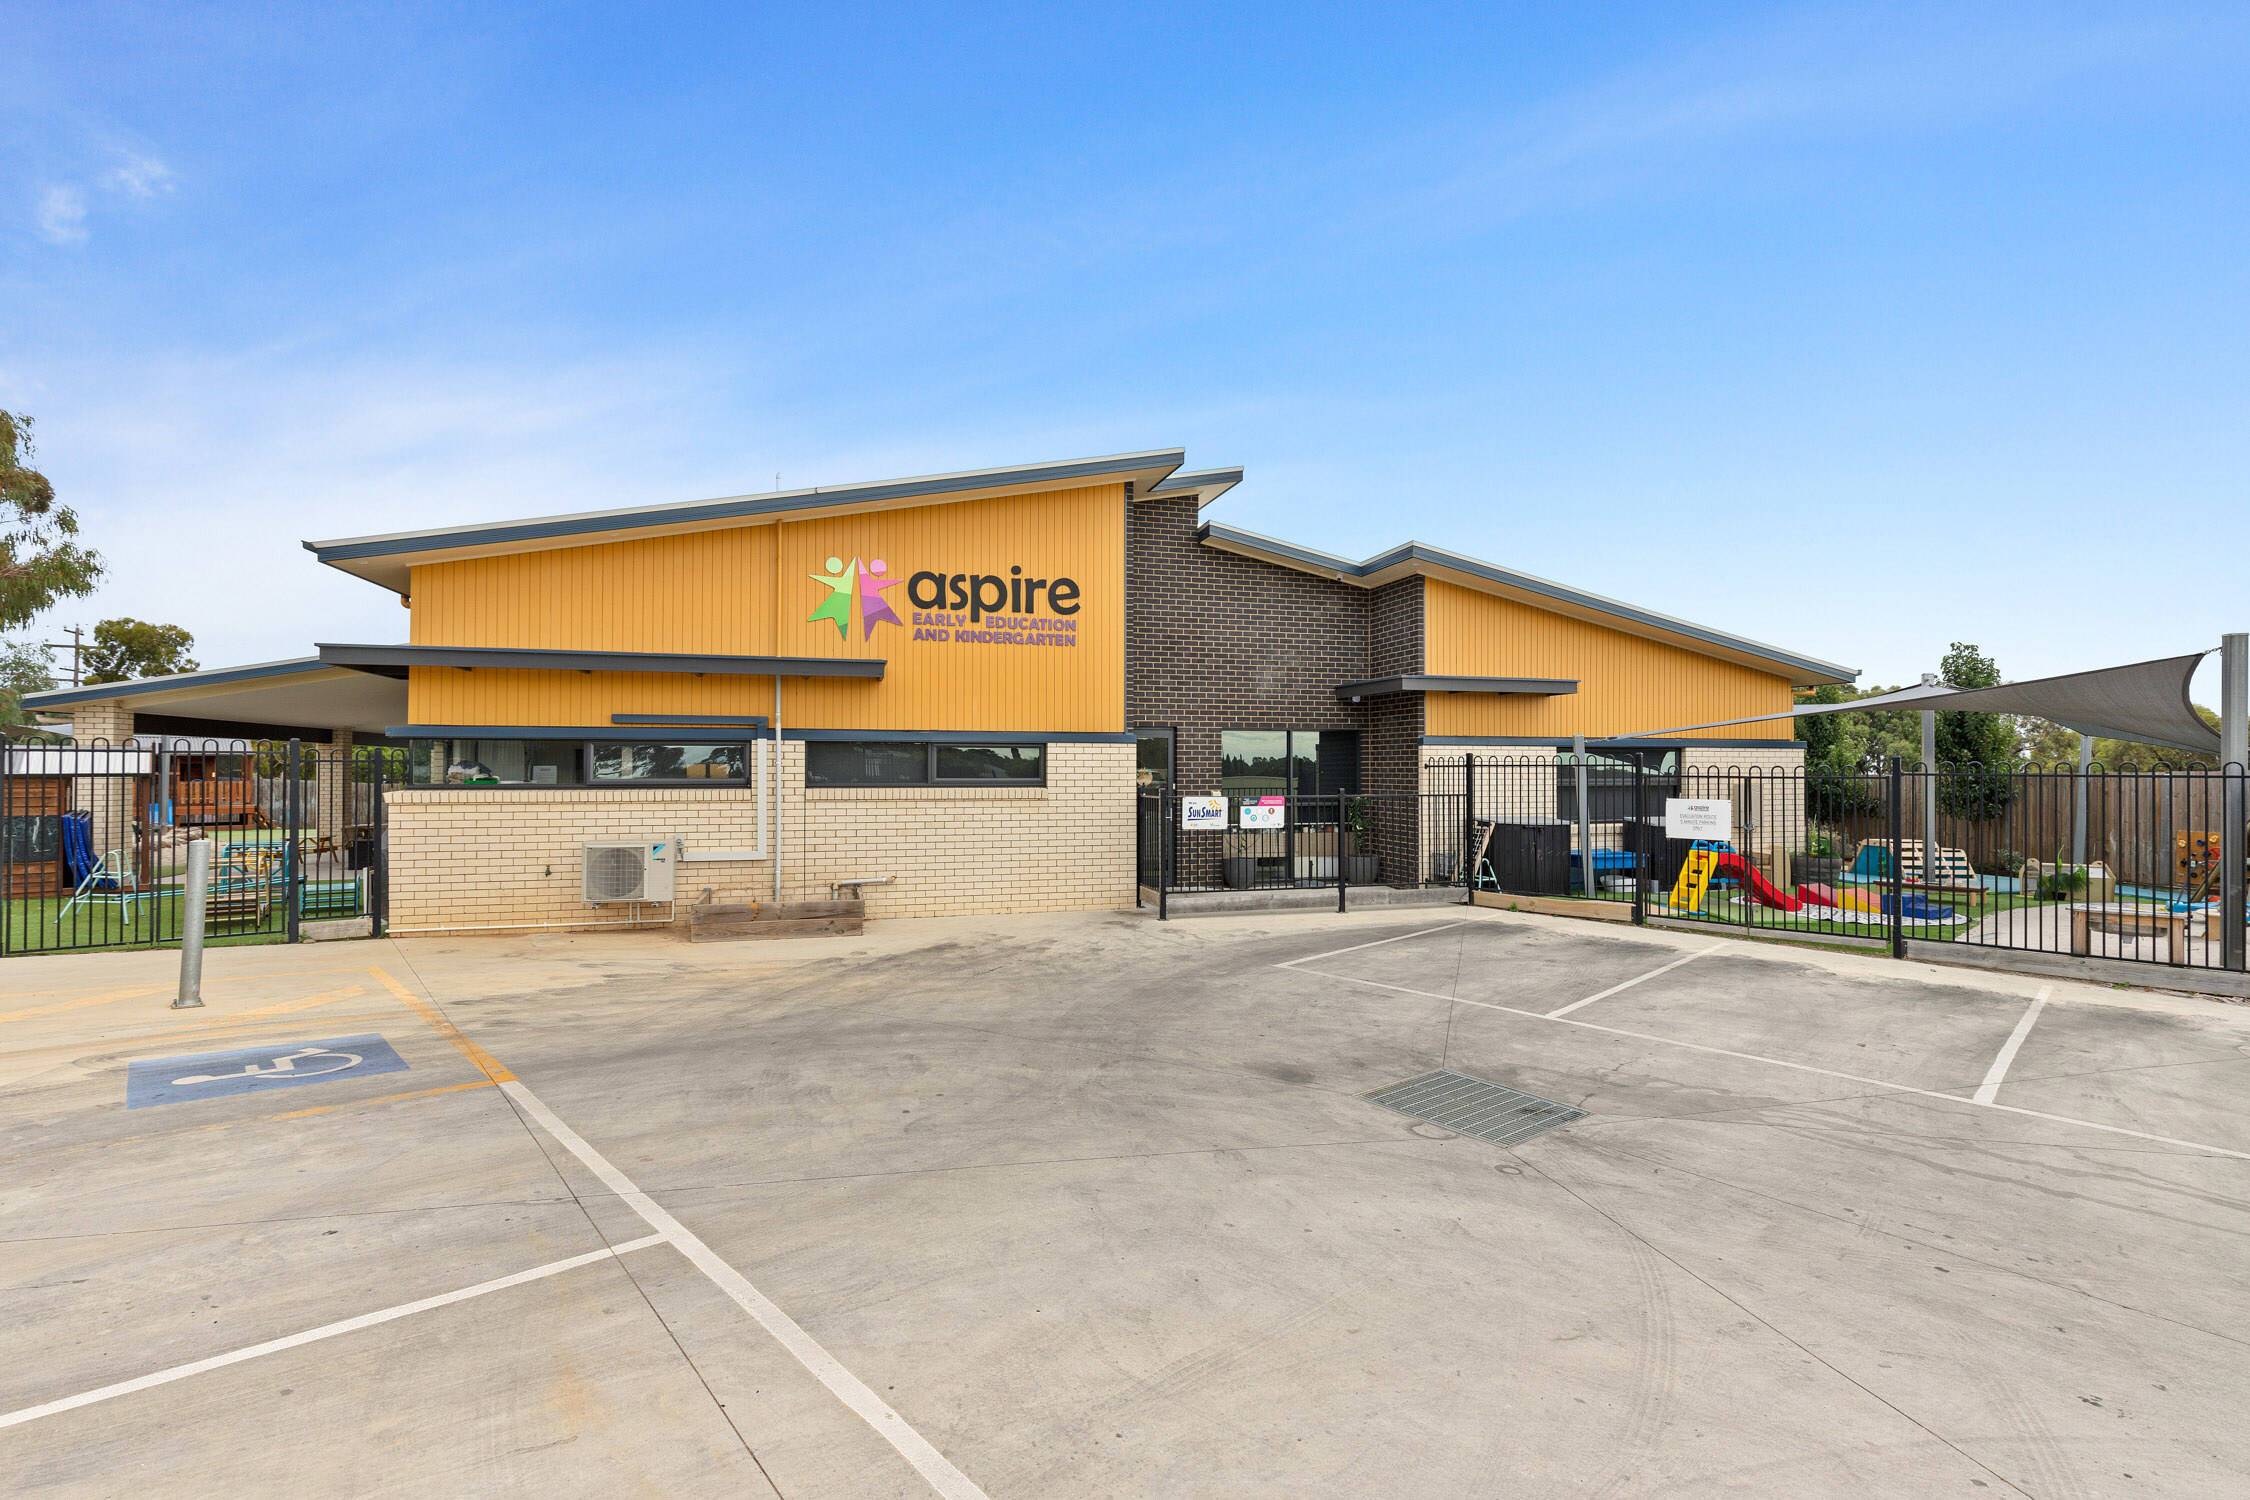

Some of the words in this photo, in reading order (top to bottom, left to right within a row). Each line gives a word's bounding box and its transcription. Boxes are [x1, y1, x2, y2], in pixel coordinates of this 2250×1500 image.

[908, 565, 1081, 623] aspire
[912, 612, 967, 627] EARLY
[985, 615, 1077, 632] EDUCATION
[912, 628, 950, 642] AND
[955, 629, 1076, 647] KINDERGARTEN
